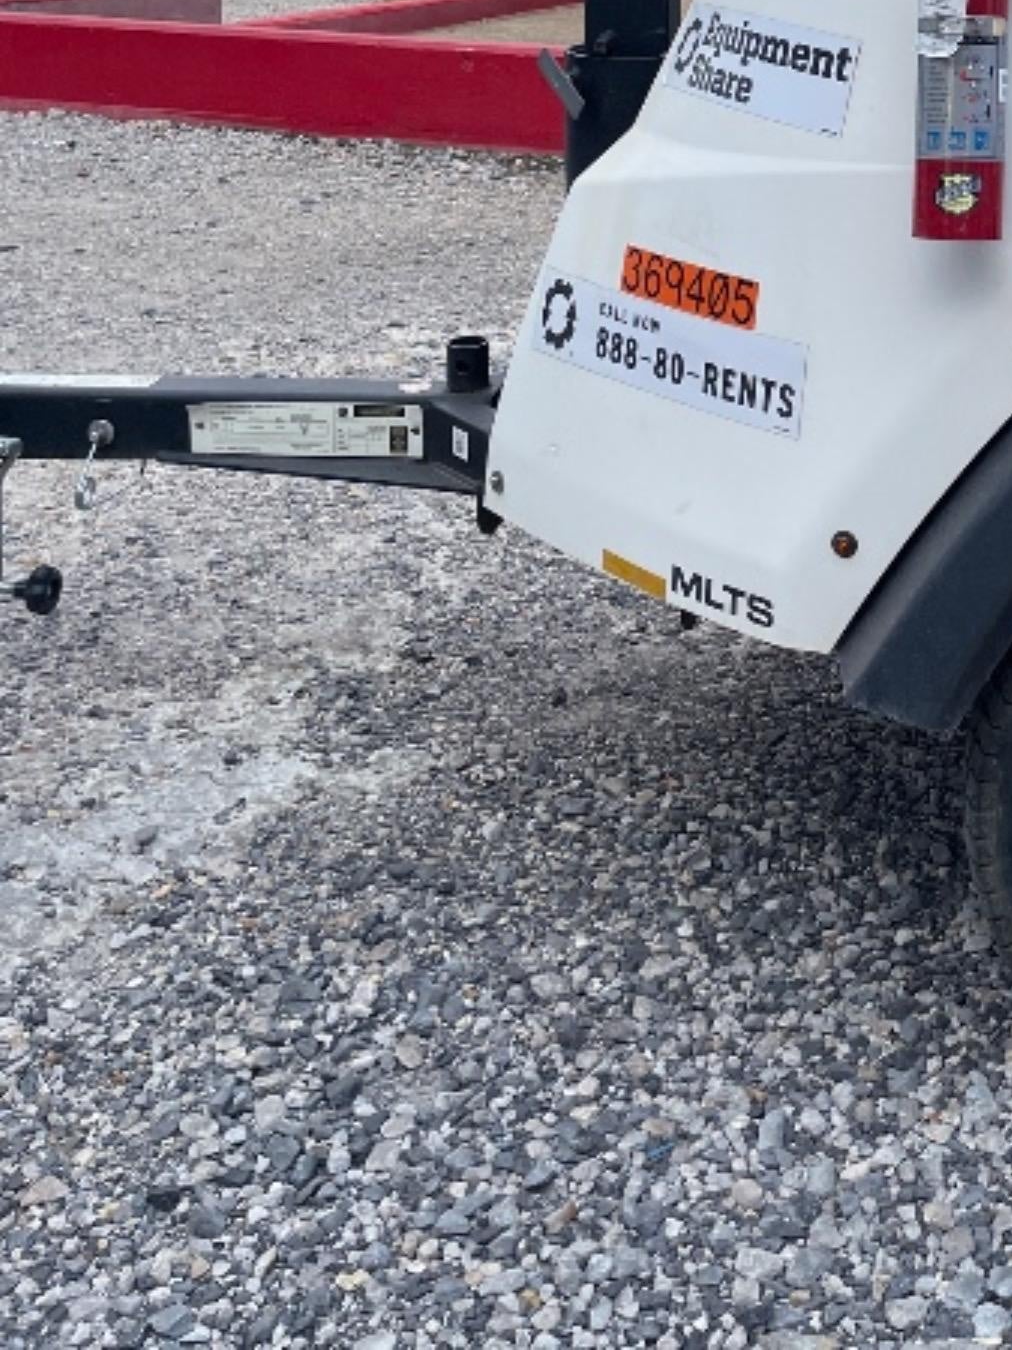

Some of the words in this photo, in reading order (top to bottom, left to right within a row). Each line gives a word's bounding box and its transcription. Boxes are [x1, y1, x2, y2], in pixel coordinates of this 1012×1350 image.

[687, 52, 753, 103] Share
[702, 11, 853, 82] Equipment
[622, 247, 755, 326] 369405
[595, 326, 796, 419] 888-80-RENTS
[671, 564, 775, 628] MLTS
